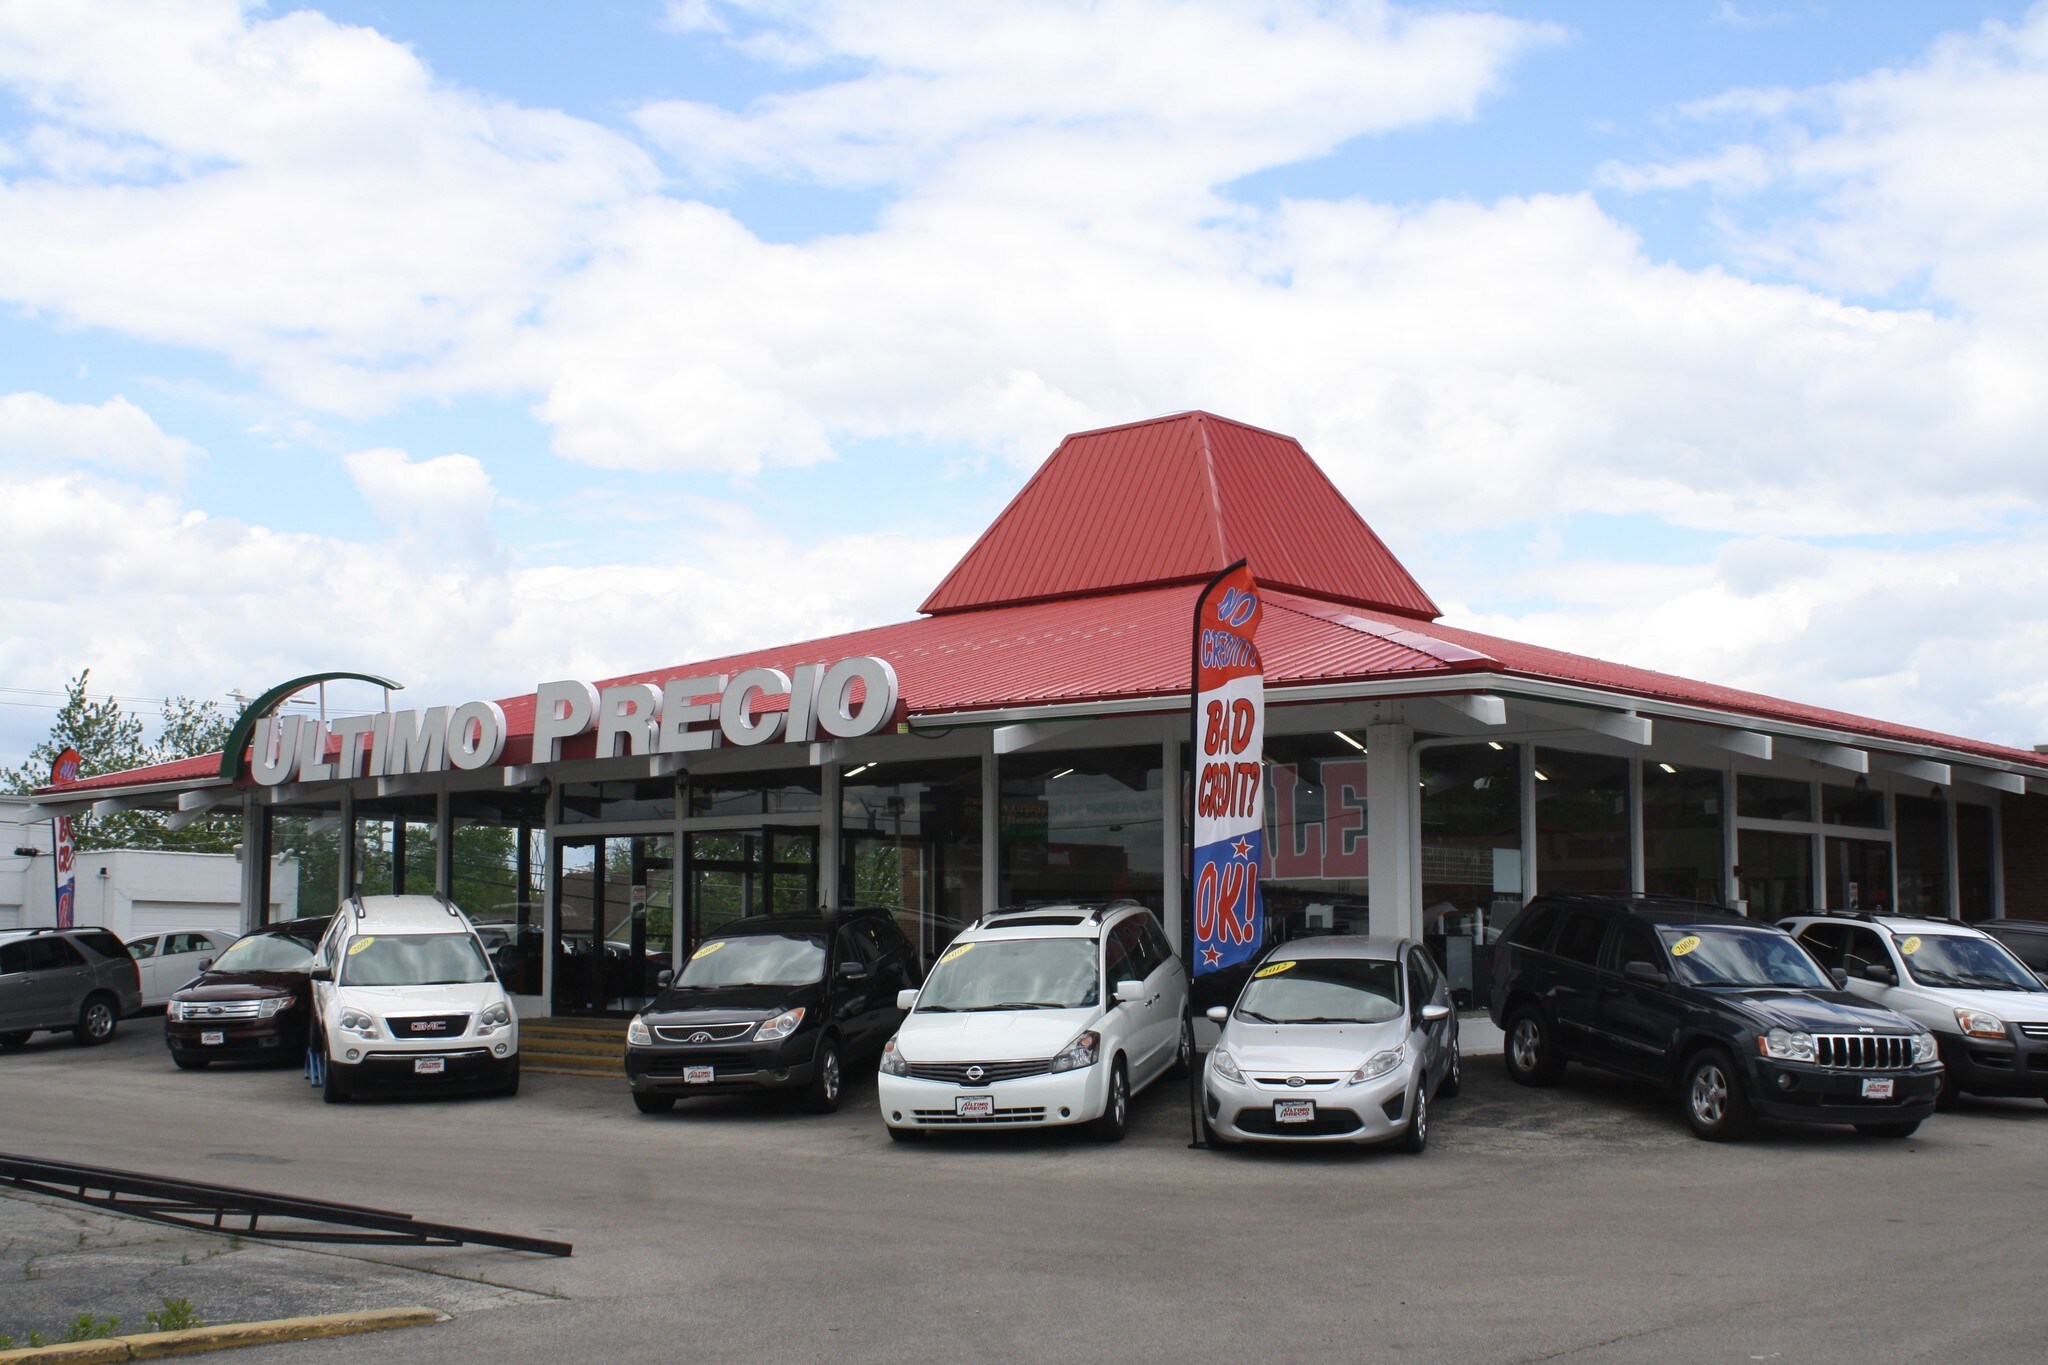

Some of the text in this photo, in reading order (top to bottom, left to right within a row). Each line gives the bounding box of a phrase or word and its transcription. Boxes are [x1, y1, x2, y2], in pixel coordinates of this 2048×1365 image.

[1217, 587, 1258, 627] NO
[251, 656, 899, 786] ULTIMO PRECIO
[1204, 698, 1255, 756] BAD
[1196, 861, 1258, 945] OK!
[1675, 937, 1695, 954] 2006
[1264, 962, 1289, 975] 2012
[411, 1021, 446, 1031] GMC
